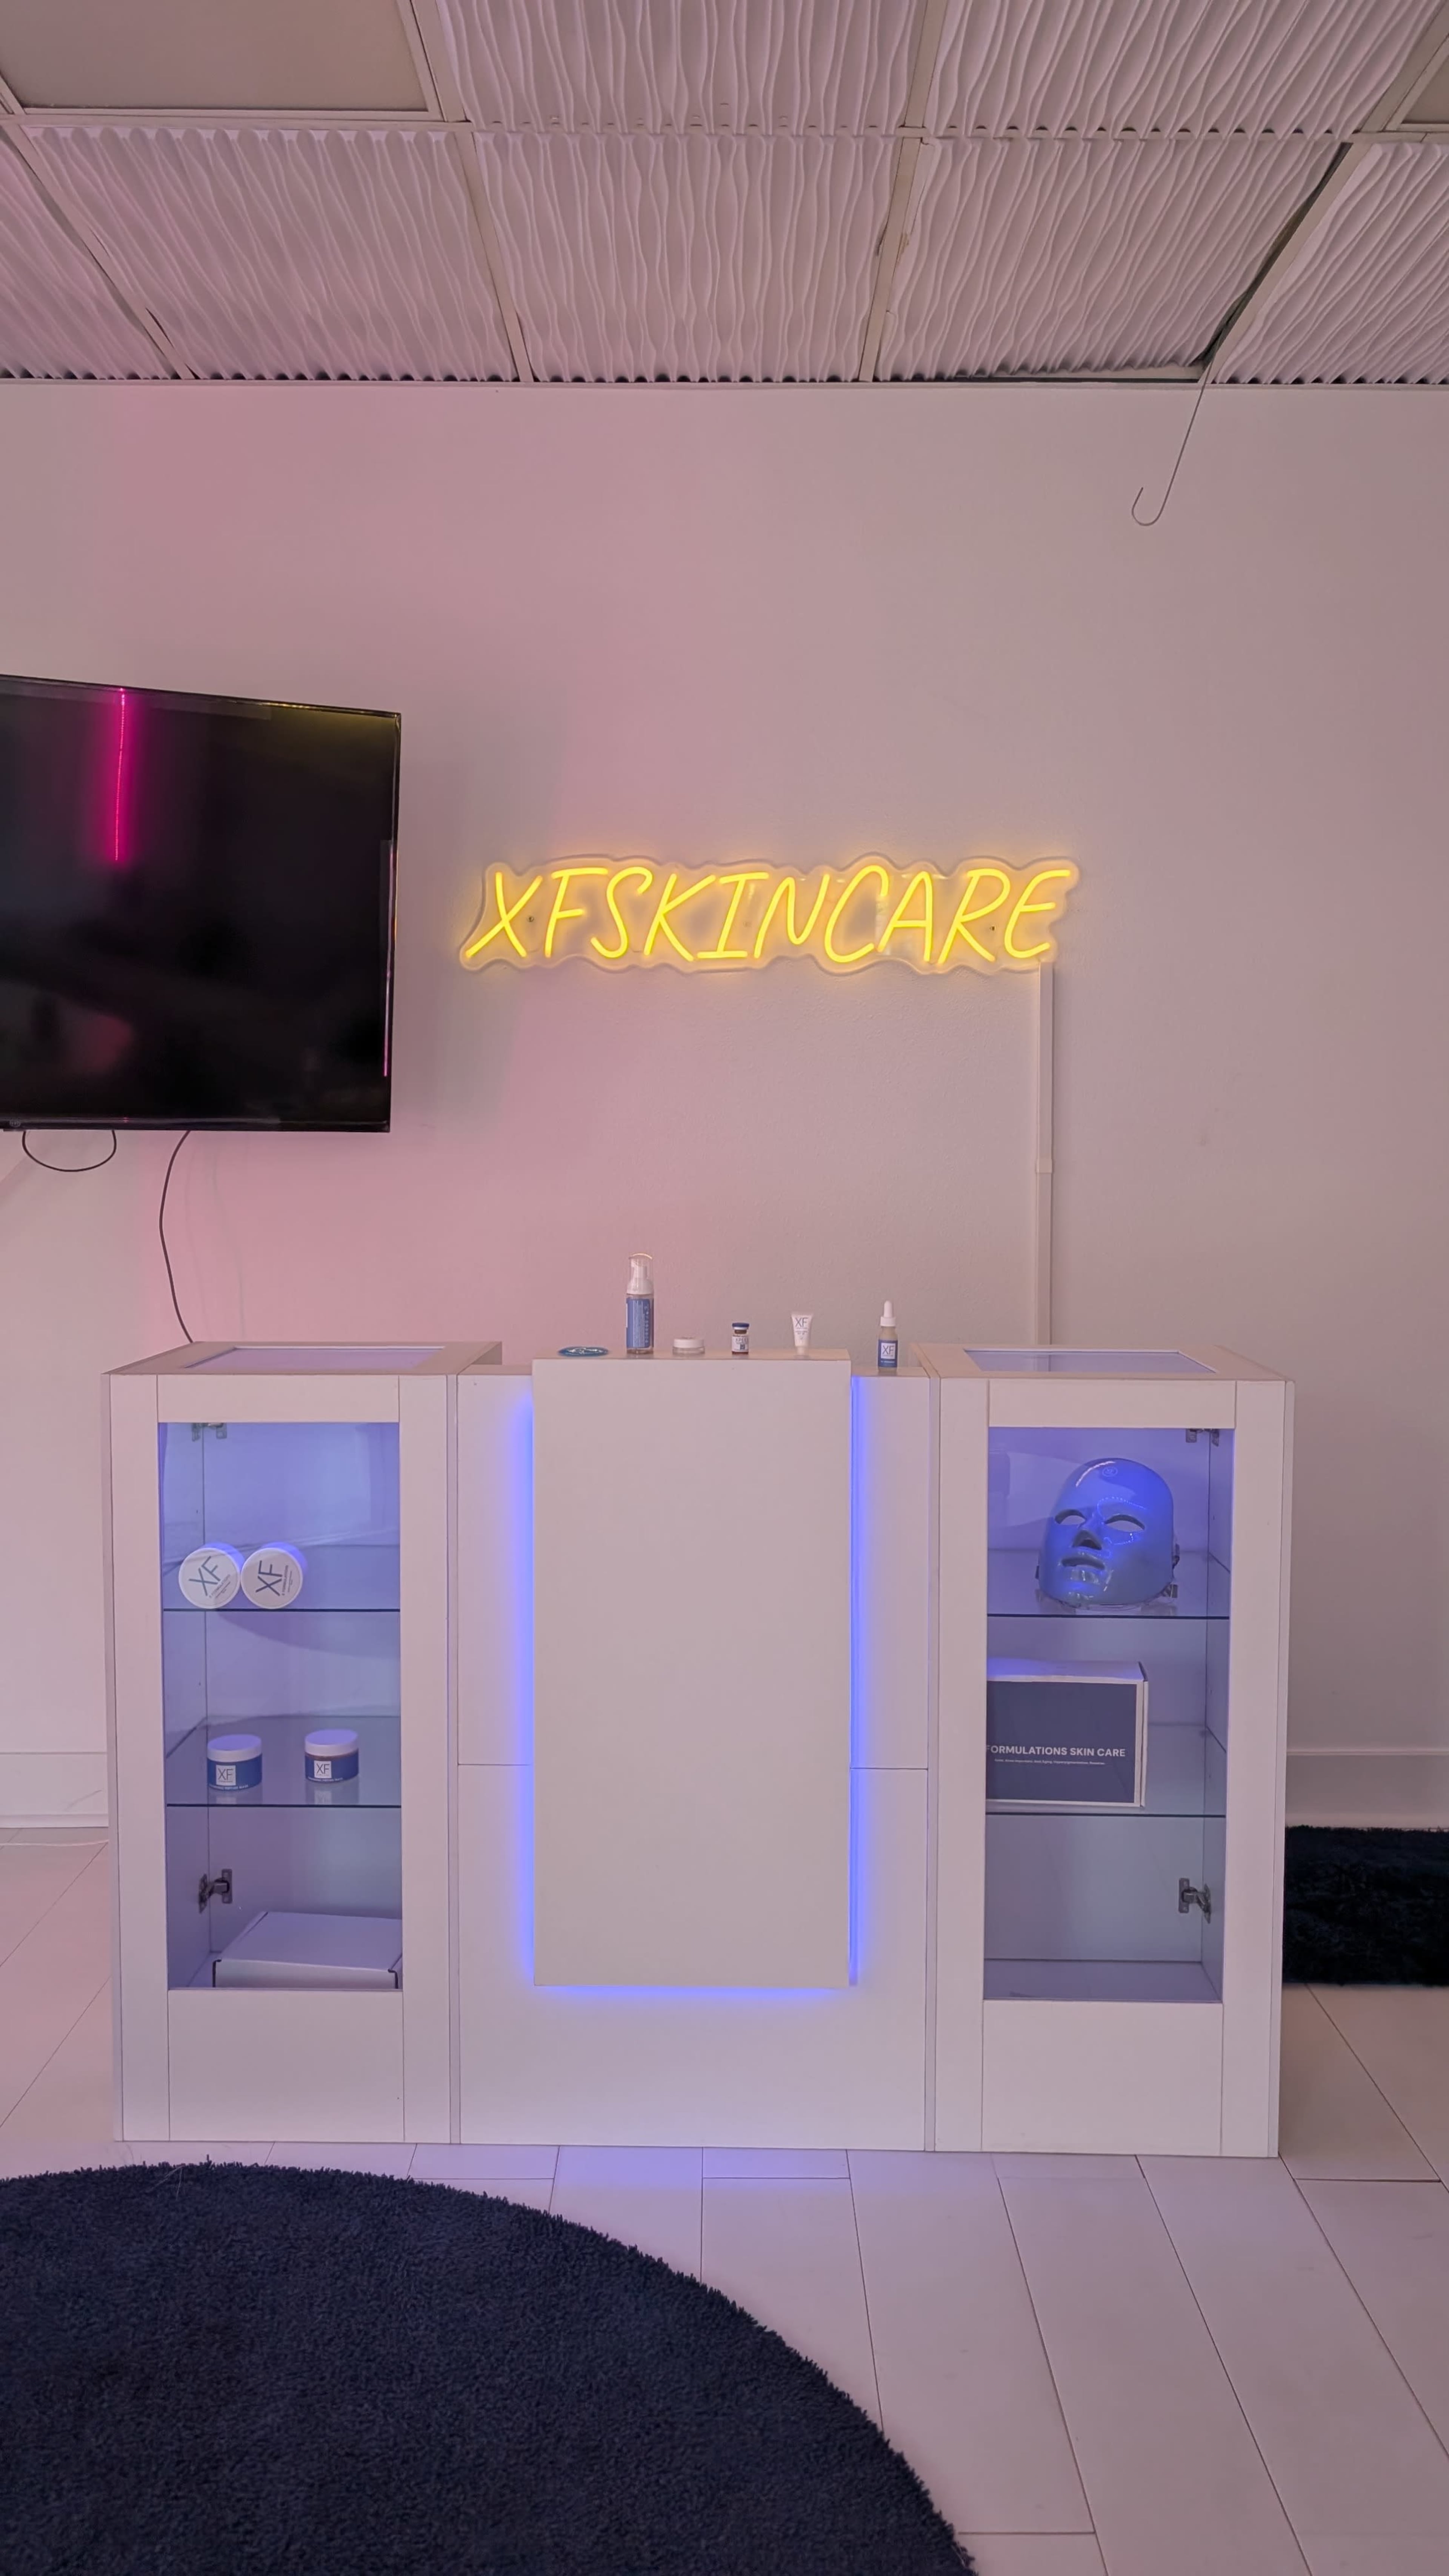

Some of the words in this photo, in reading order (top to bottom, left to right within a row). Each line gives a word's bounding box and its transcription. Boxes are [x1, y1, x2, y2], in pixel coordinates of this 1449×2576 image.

[465, 864, 1072, 963] XFSKINCARE
[795, 1317, 809, 1327] XF
[883, 1345, 894, 1355] XF
[189, 1556, 221, 1596] XF
[255, 1560, 283, 1596] XF
[1070, 1747, 1094, 1756] SKIN
[1097, 1748, 1125, 1757] CARE
[218, 1768, 233, 1780] XF
[316, 1763, 330, 1774] XF
